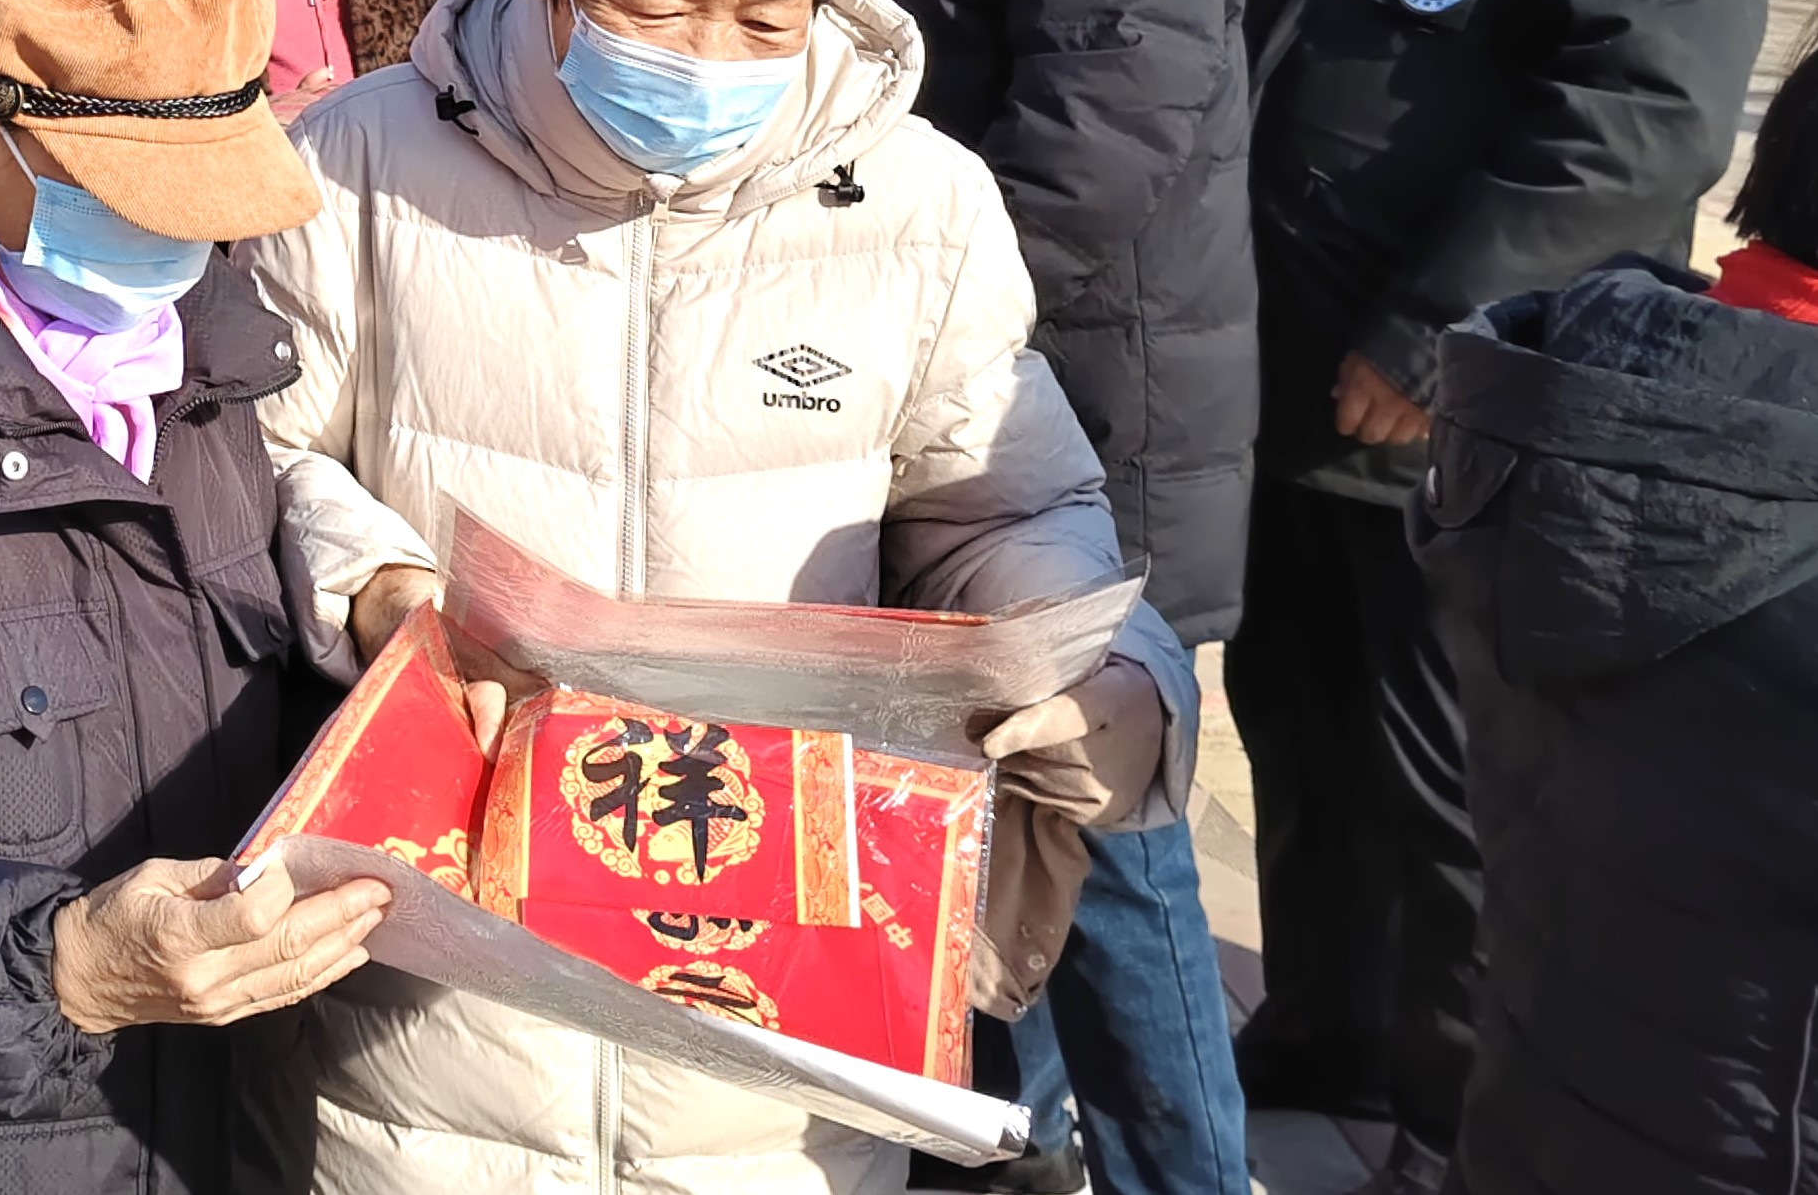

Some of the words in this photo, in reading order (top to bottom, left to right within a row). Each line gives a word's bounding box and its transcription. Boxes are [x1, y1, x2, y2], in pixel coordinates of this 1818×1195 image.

[762, 391, 841, 413] umbro
[580, 718, 748, 883] 祥
[859, 882, 913, 950] 中国
